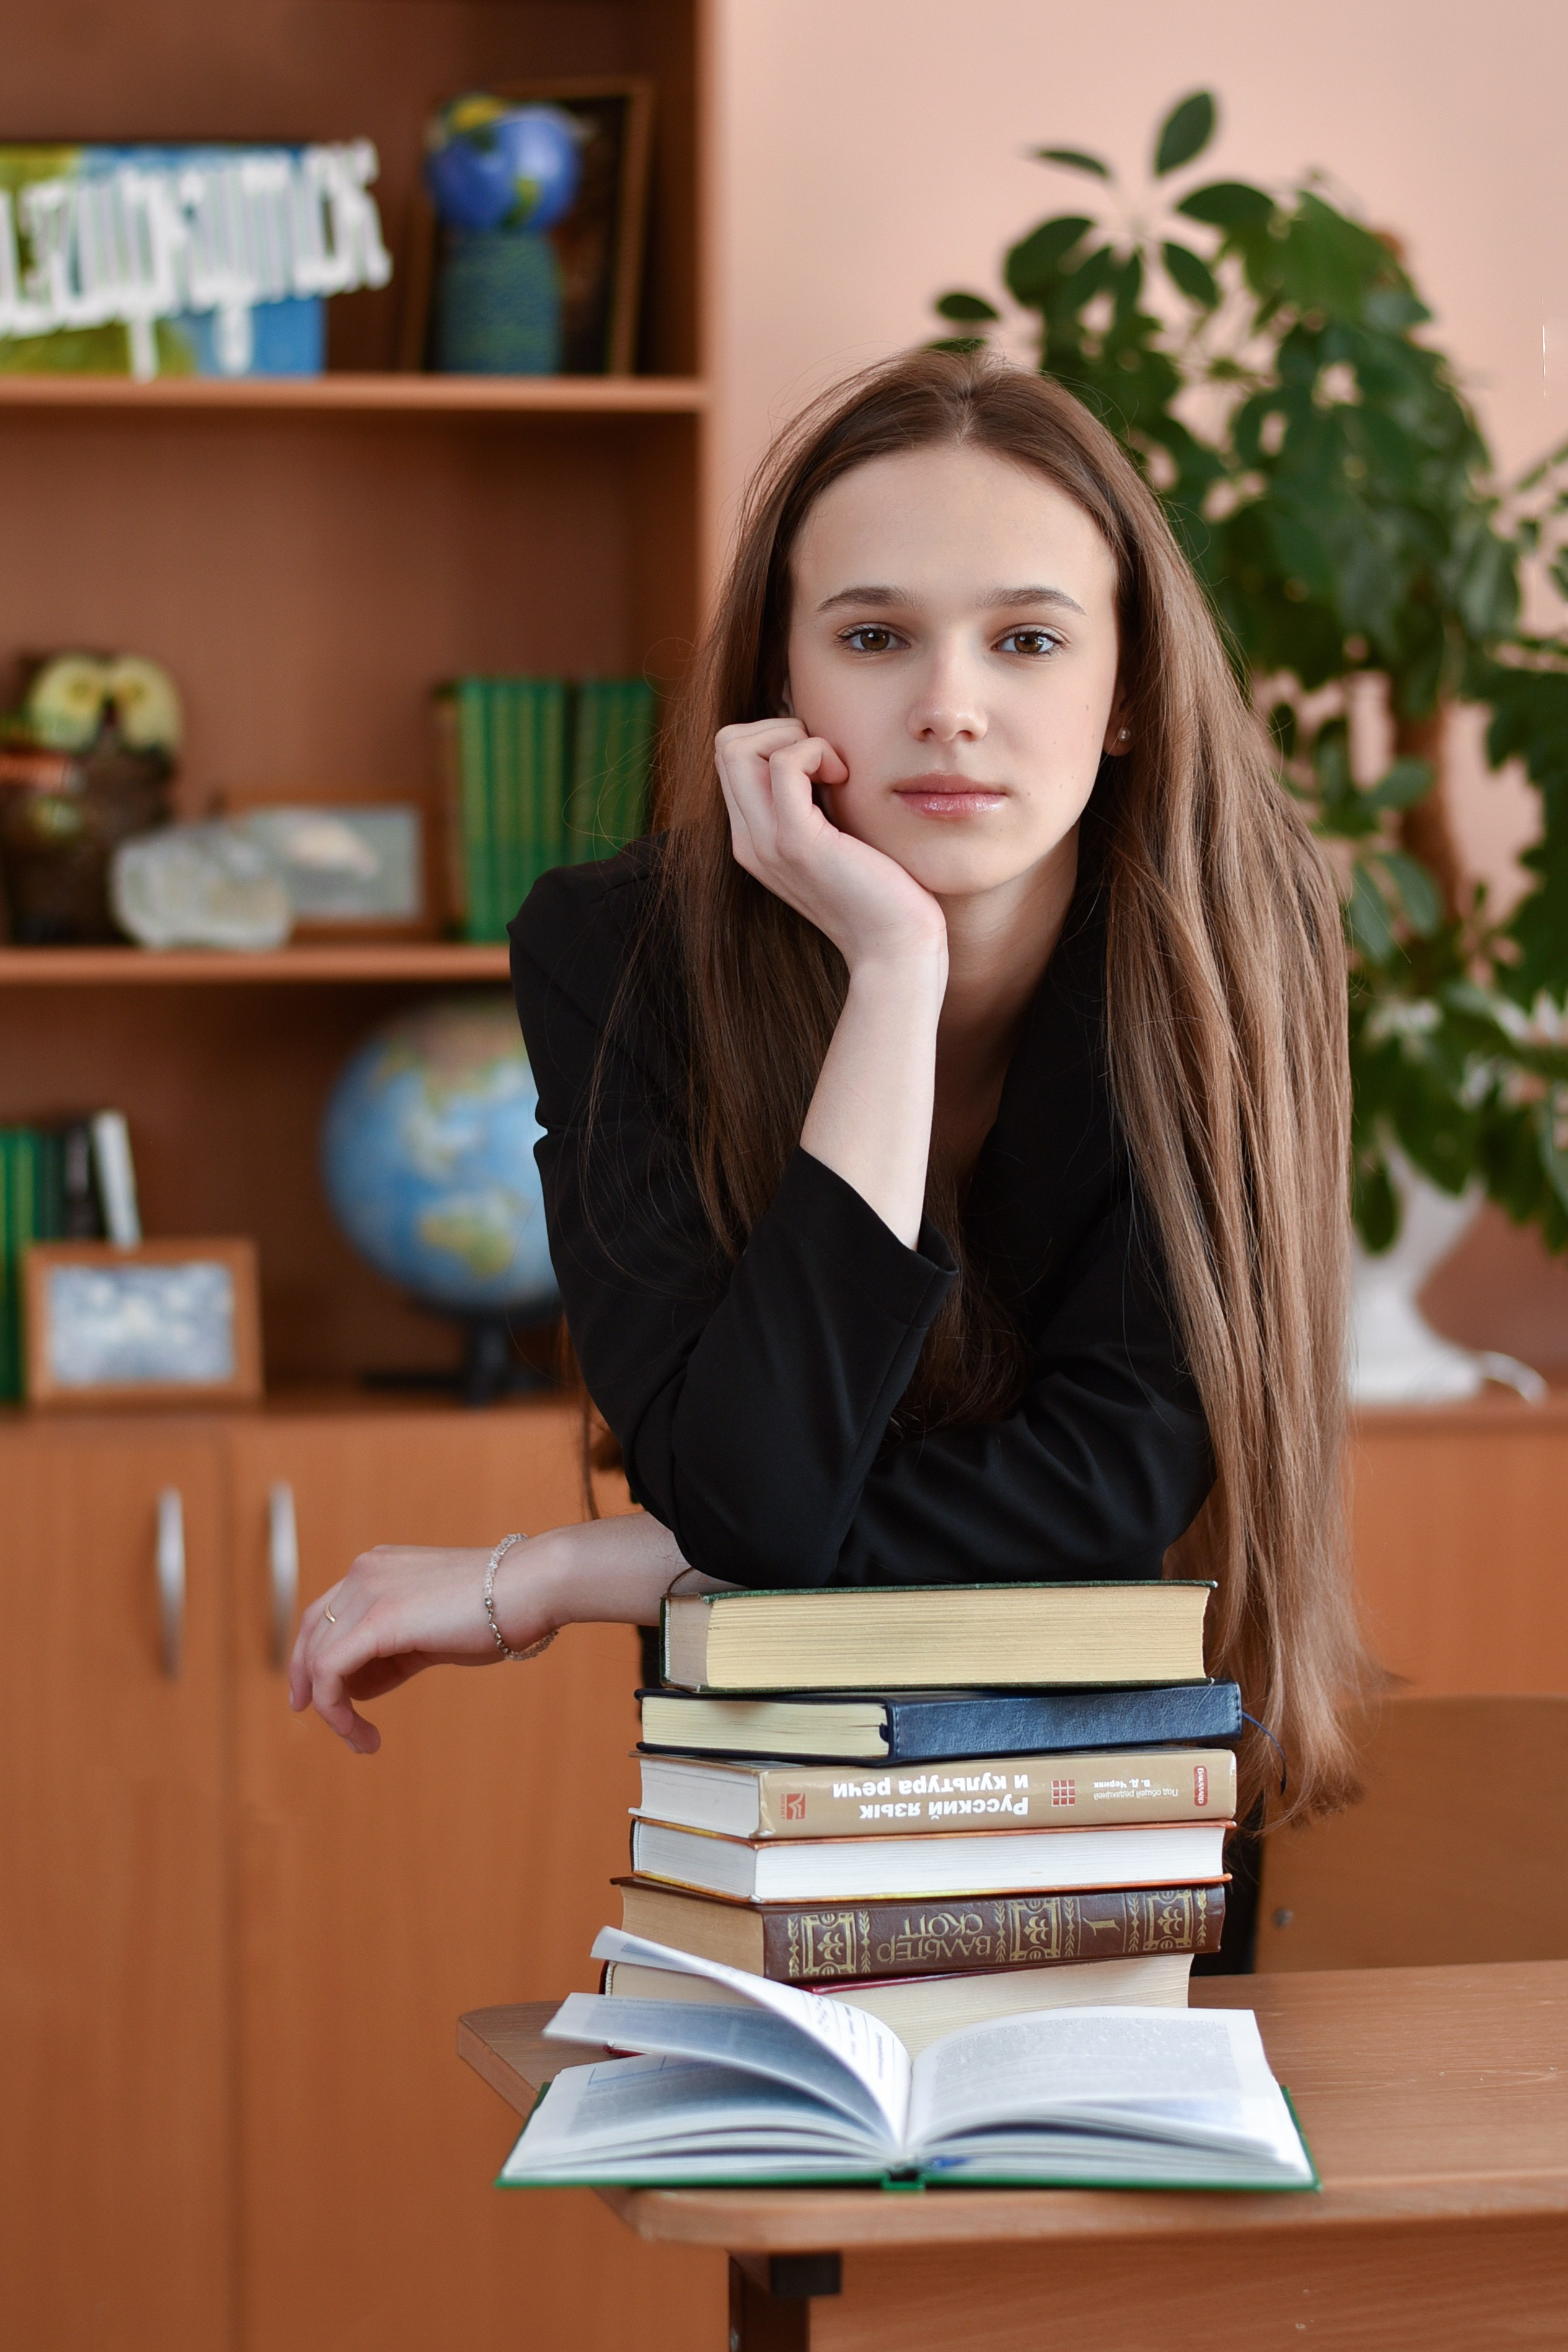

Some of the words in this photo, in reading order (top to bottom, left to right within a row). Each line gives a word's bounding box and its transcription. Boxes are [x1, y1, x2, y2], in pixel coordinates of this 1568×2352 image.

[833, 1776, 891, 1798] речи
[898, 1771, 1007, 1795] культура
[1013, 1774, 1029, 1789] и
[1093, 1779, 1127, 1789] Черняк
[1129, 1778, 1139, 1788] Д.
[1140, 1779, 1150, 1787] В.
[1093, 1789, 1135, 1800] редакцией
[1136, 1789, 1161, 1798] общей
[1162, 1788, 1178, 1797] Под
[859, 1802, 921, 1819] язык
[928, 1794, 1029, 1820] Русский
[898, 1912, 984, 1940] СКОТТ
[876, 1934, 992, 1965] ВАЛЬТЕР
